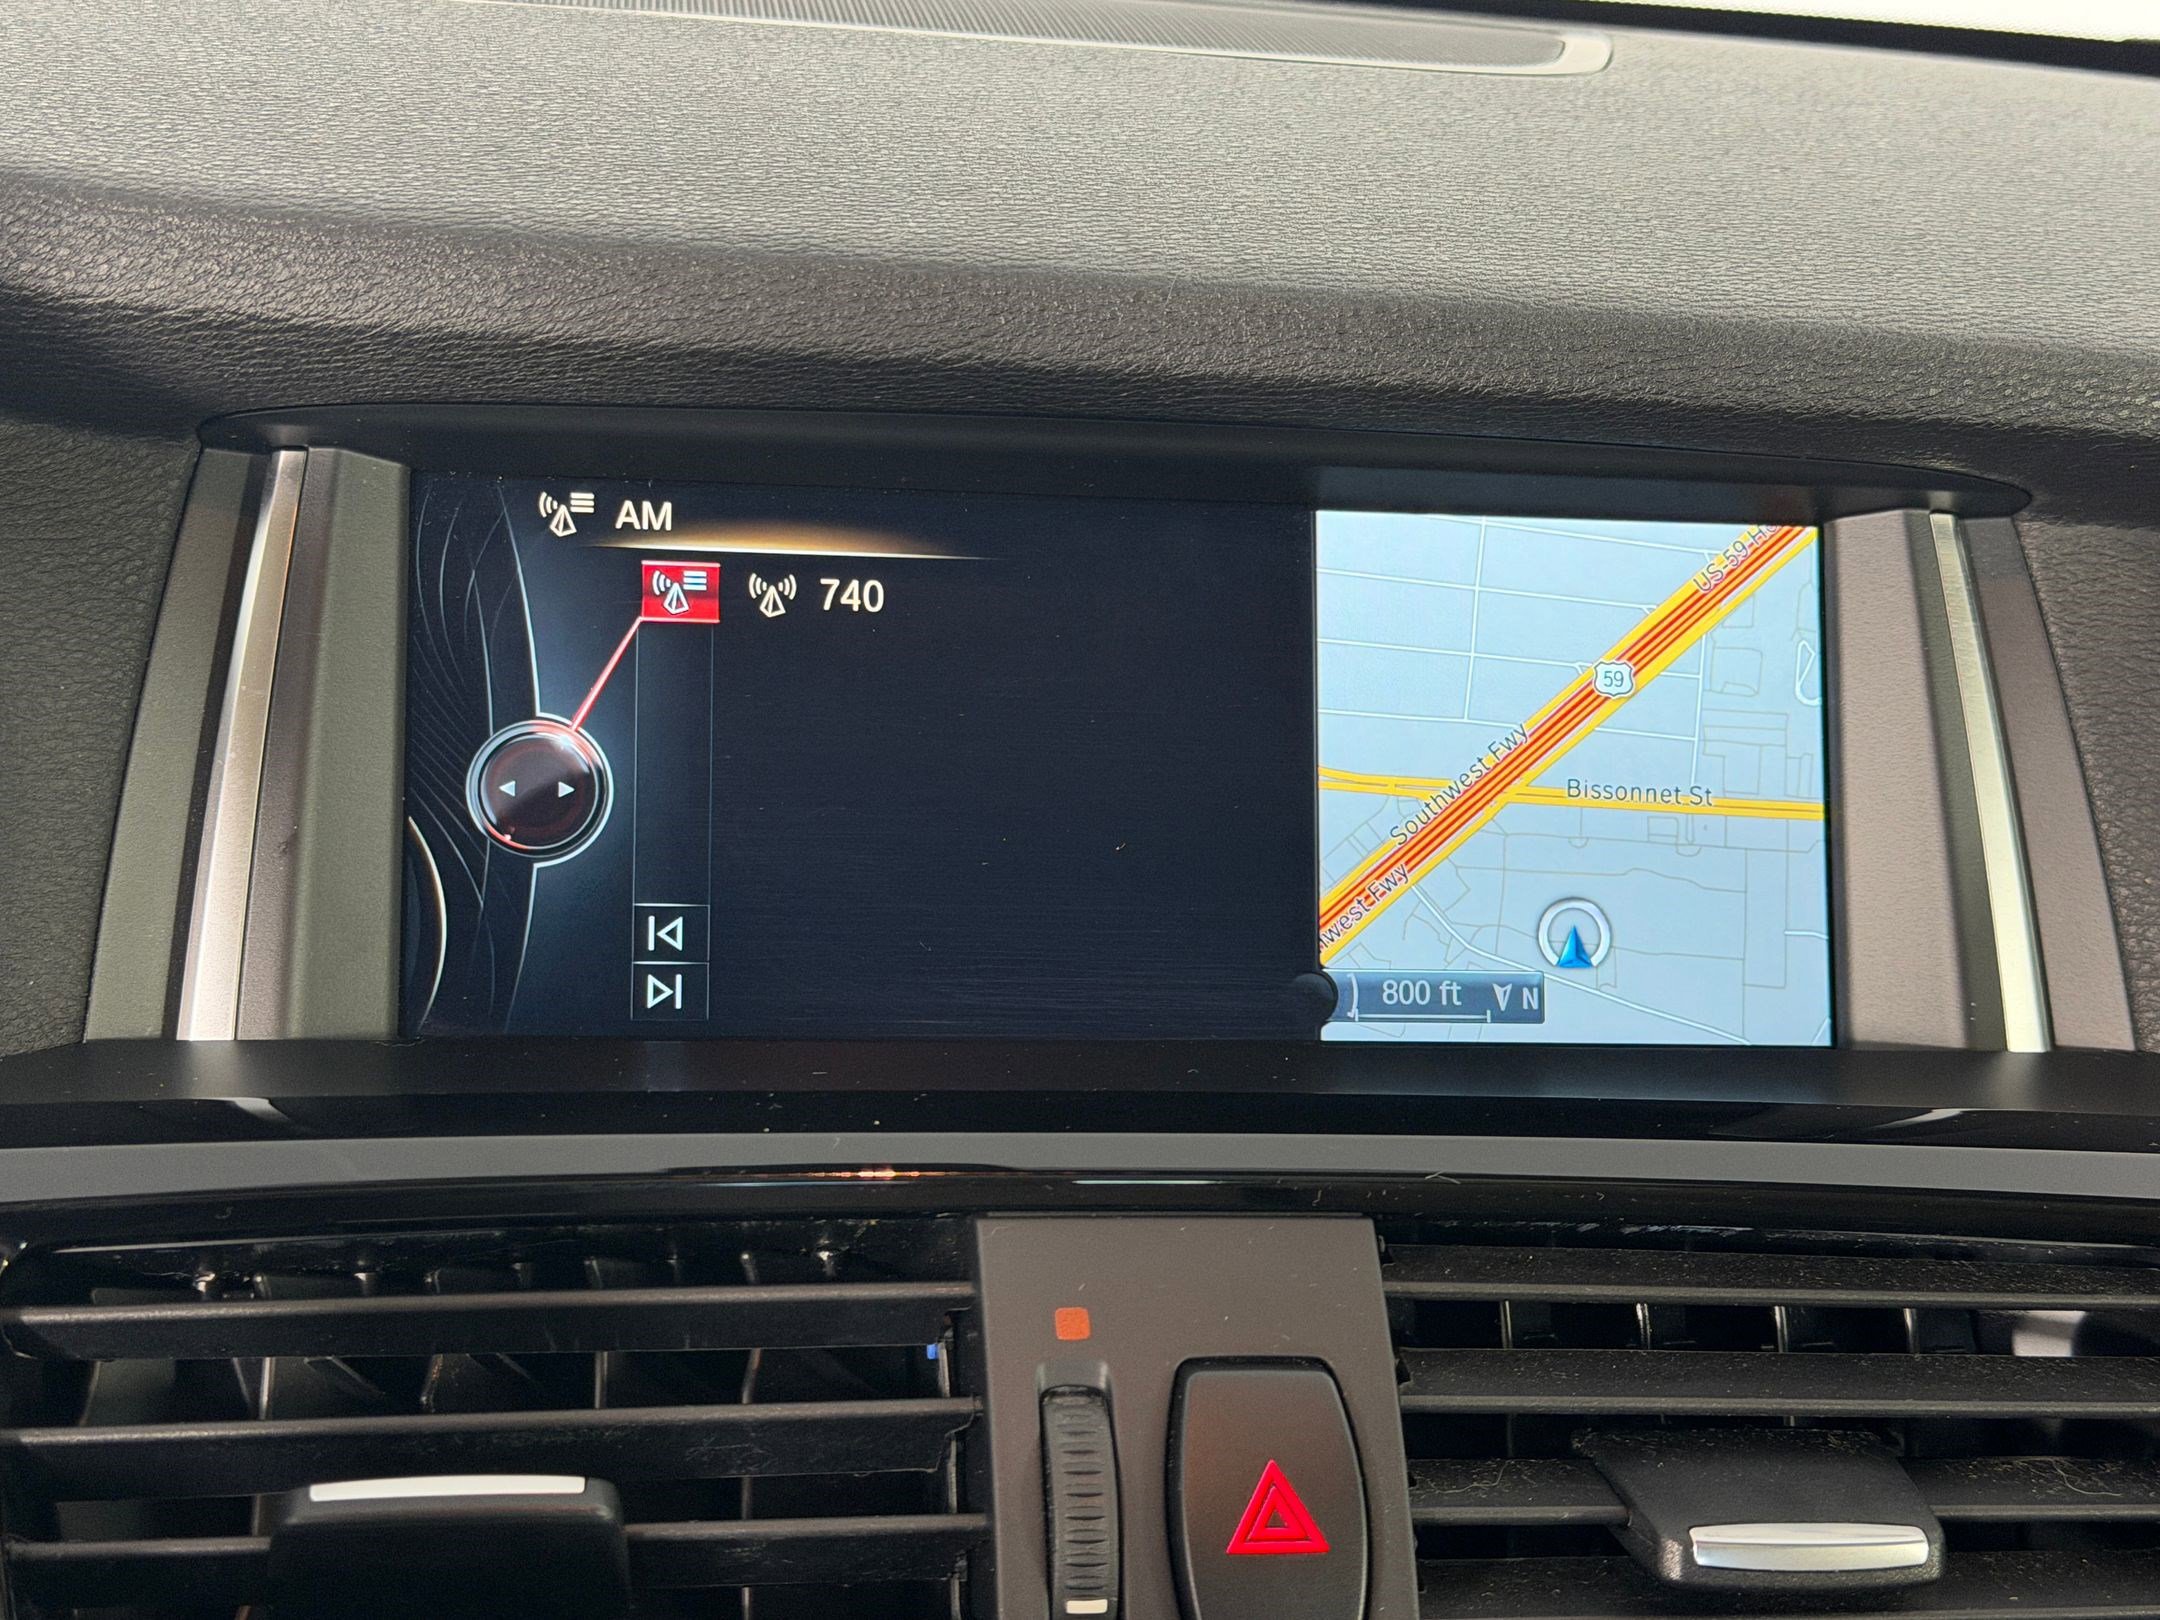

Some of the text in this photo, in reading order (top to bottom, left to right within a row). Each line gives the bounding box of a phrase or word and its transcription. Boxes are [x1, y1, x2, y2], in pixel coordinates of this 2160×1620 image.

[615, 500, 673, 531] AM
[1693, 540, 1749, 592] US-59
[820, 578, 885, 613] 740
[1603, 671, 1624, 688] 59
[1390, 724, 1528, 845] Southwest Fwy
[1567, 779, 1713, 806] Bissonnet St
[1366, 863, 1409, 903] Fwy
[1382, 979, 1462, 1006] 800 ft
[1522, 987, 1539, 1010] N
